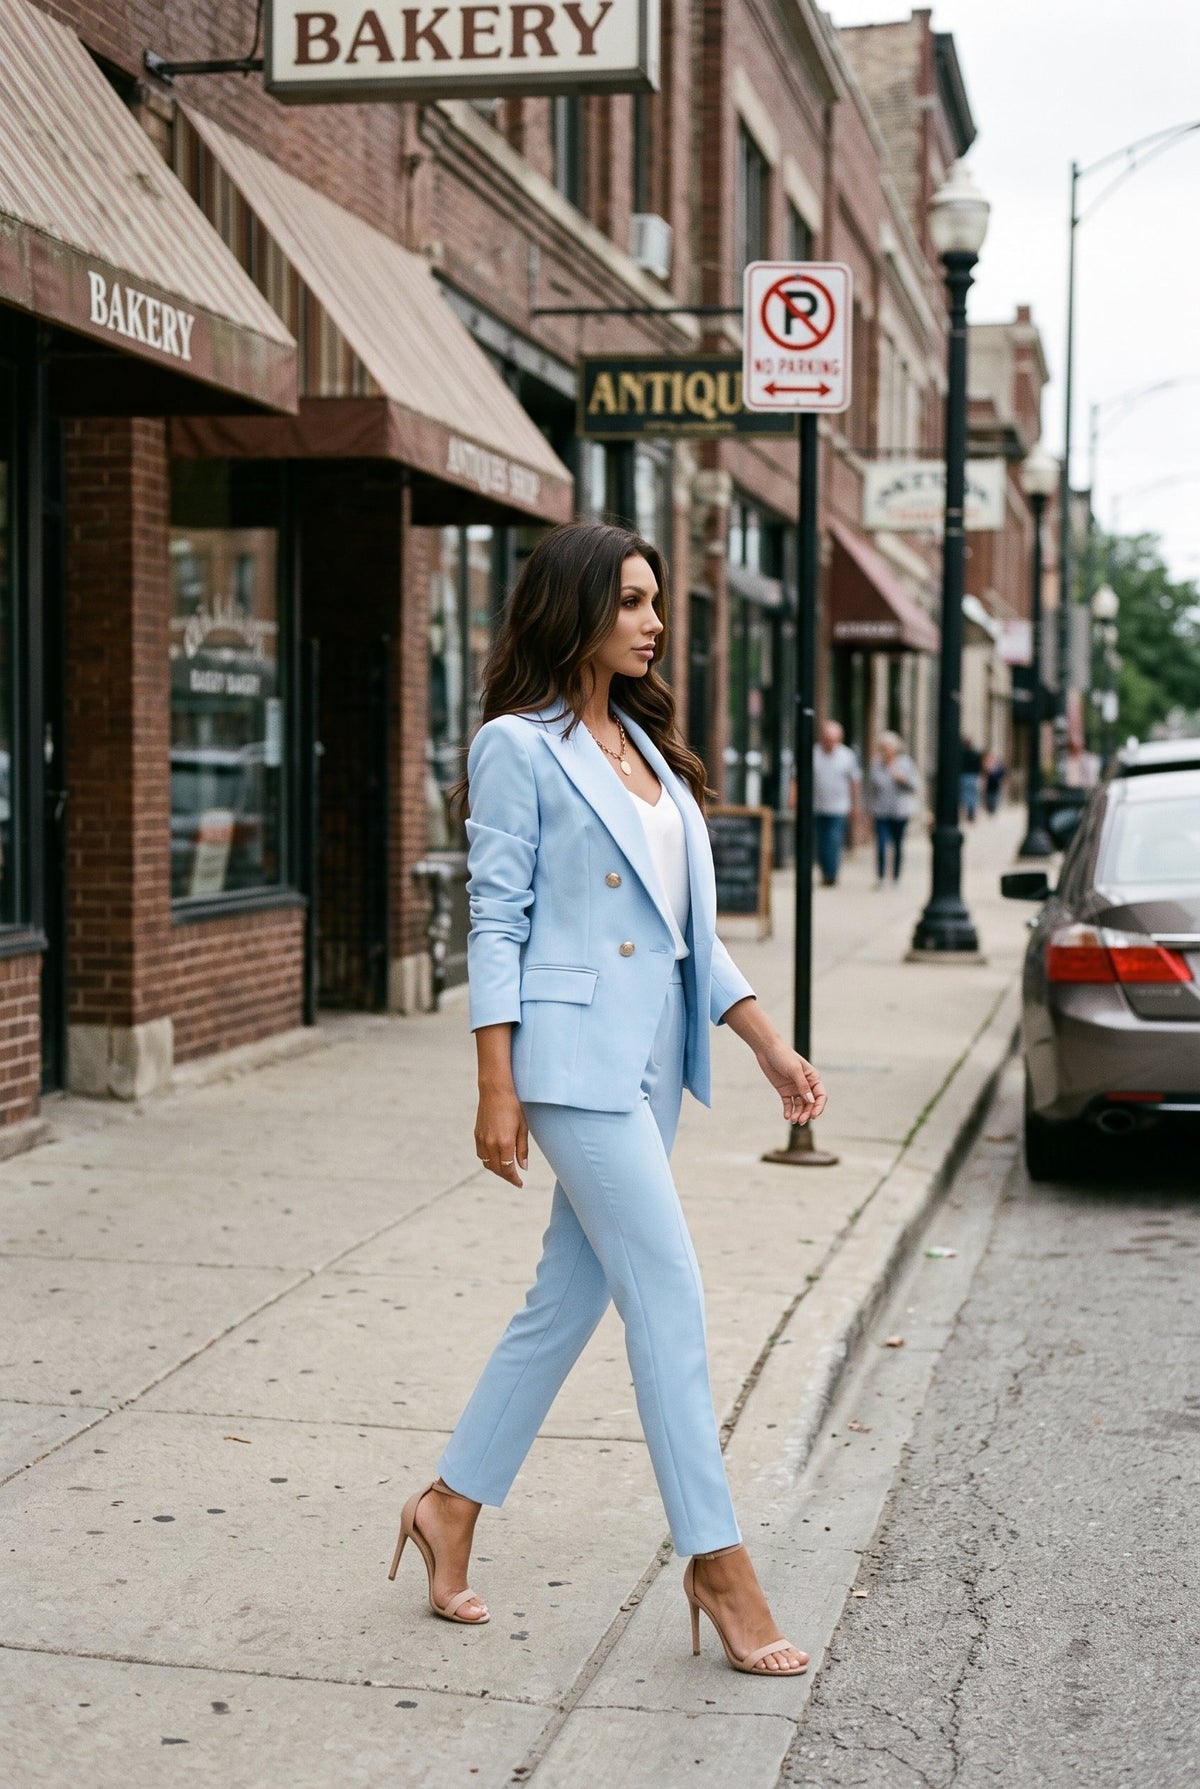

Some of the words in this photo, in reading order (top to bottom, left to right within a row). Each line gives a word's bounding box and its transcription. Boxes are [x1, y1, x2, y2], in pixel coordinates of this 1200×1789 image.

[293, 1, 614, 65] BAKERY
[87, 270, 195, 361] BAKERY
[587, 371, 746, 420] ANTIQU
[754, 359, 774, 375] NO
[779, 359, 840, 376] PARKING
